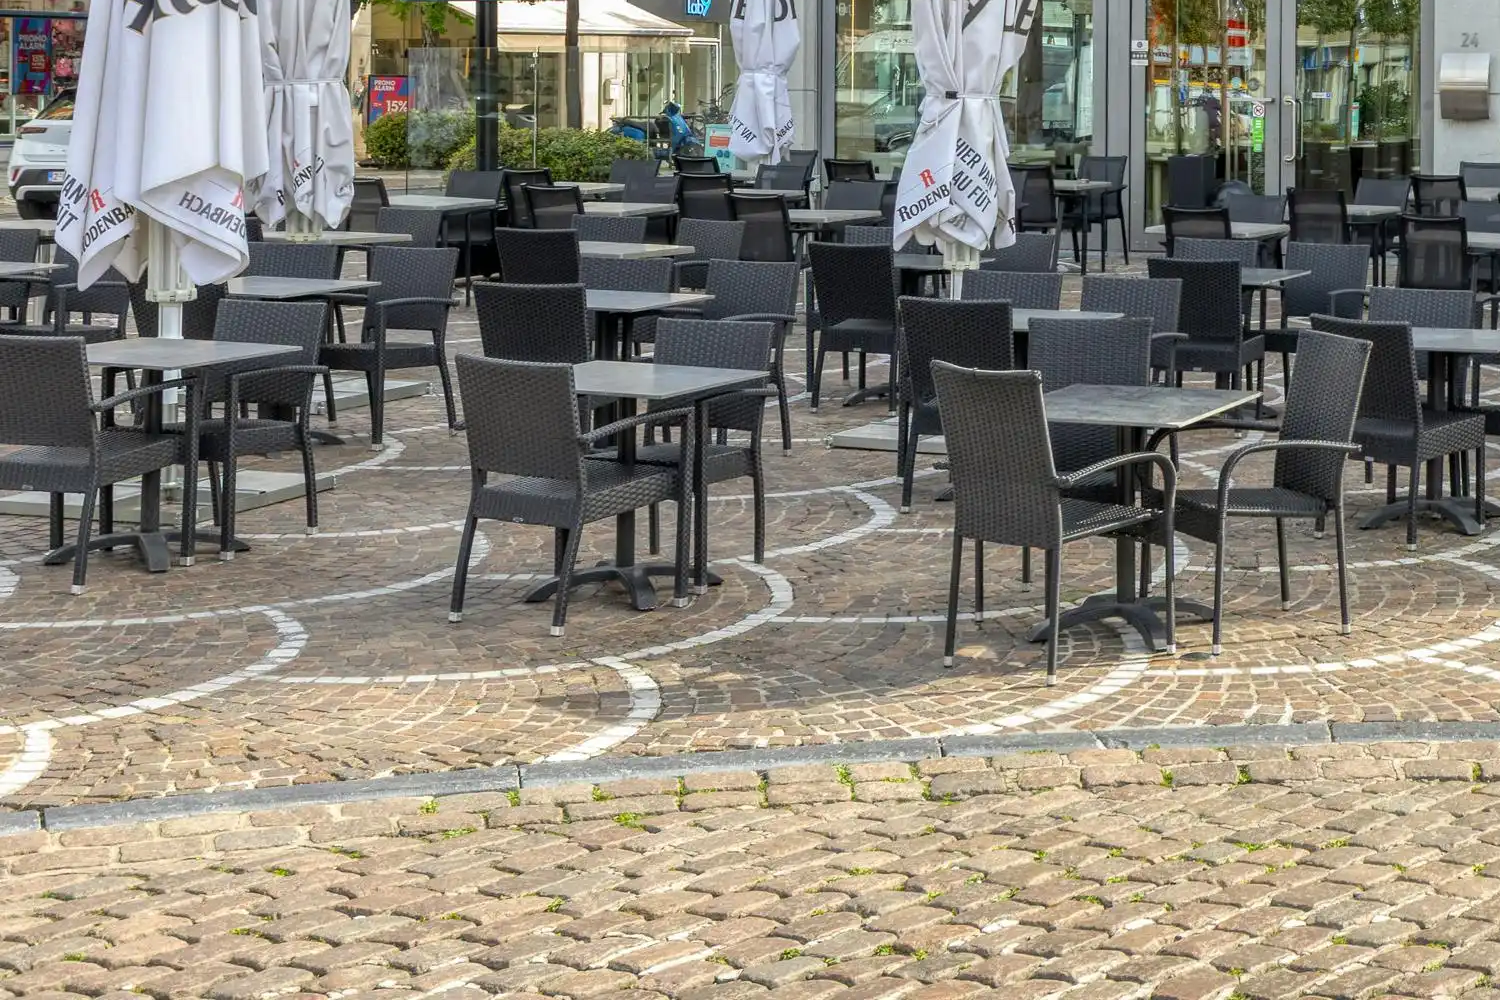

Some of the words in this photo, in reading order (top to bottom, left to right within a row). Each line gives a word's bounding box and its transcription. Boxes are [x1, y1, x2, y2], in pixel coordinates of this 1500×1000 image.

[1460, 32, 1479, 48] 24
[385, 100, 408, 112] 15%
[920, 168, 936, 188] R
[952, 170, 973, 193] AU
[90, 188, 106, 213] R
[897, 182, 952, 223] RODENB
